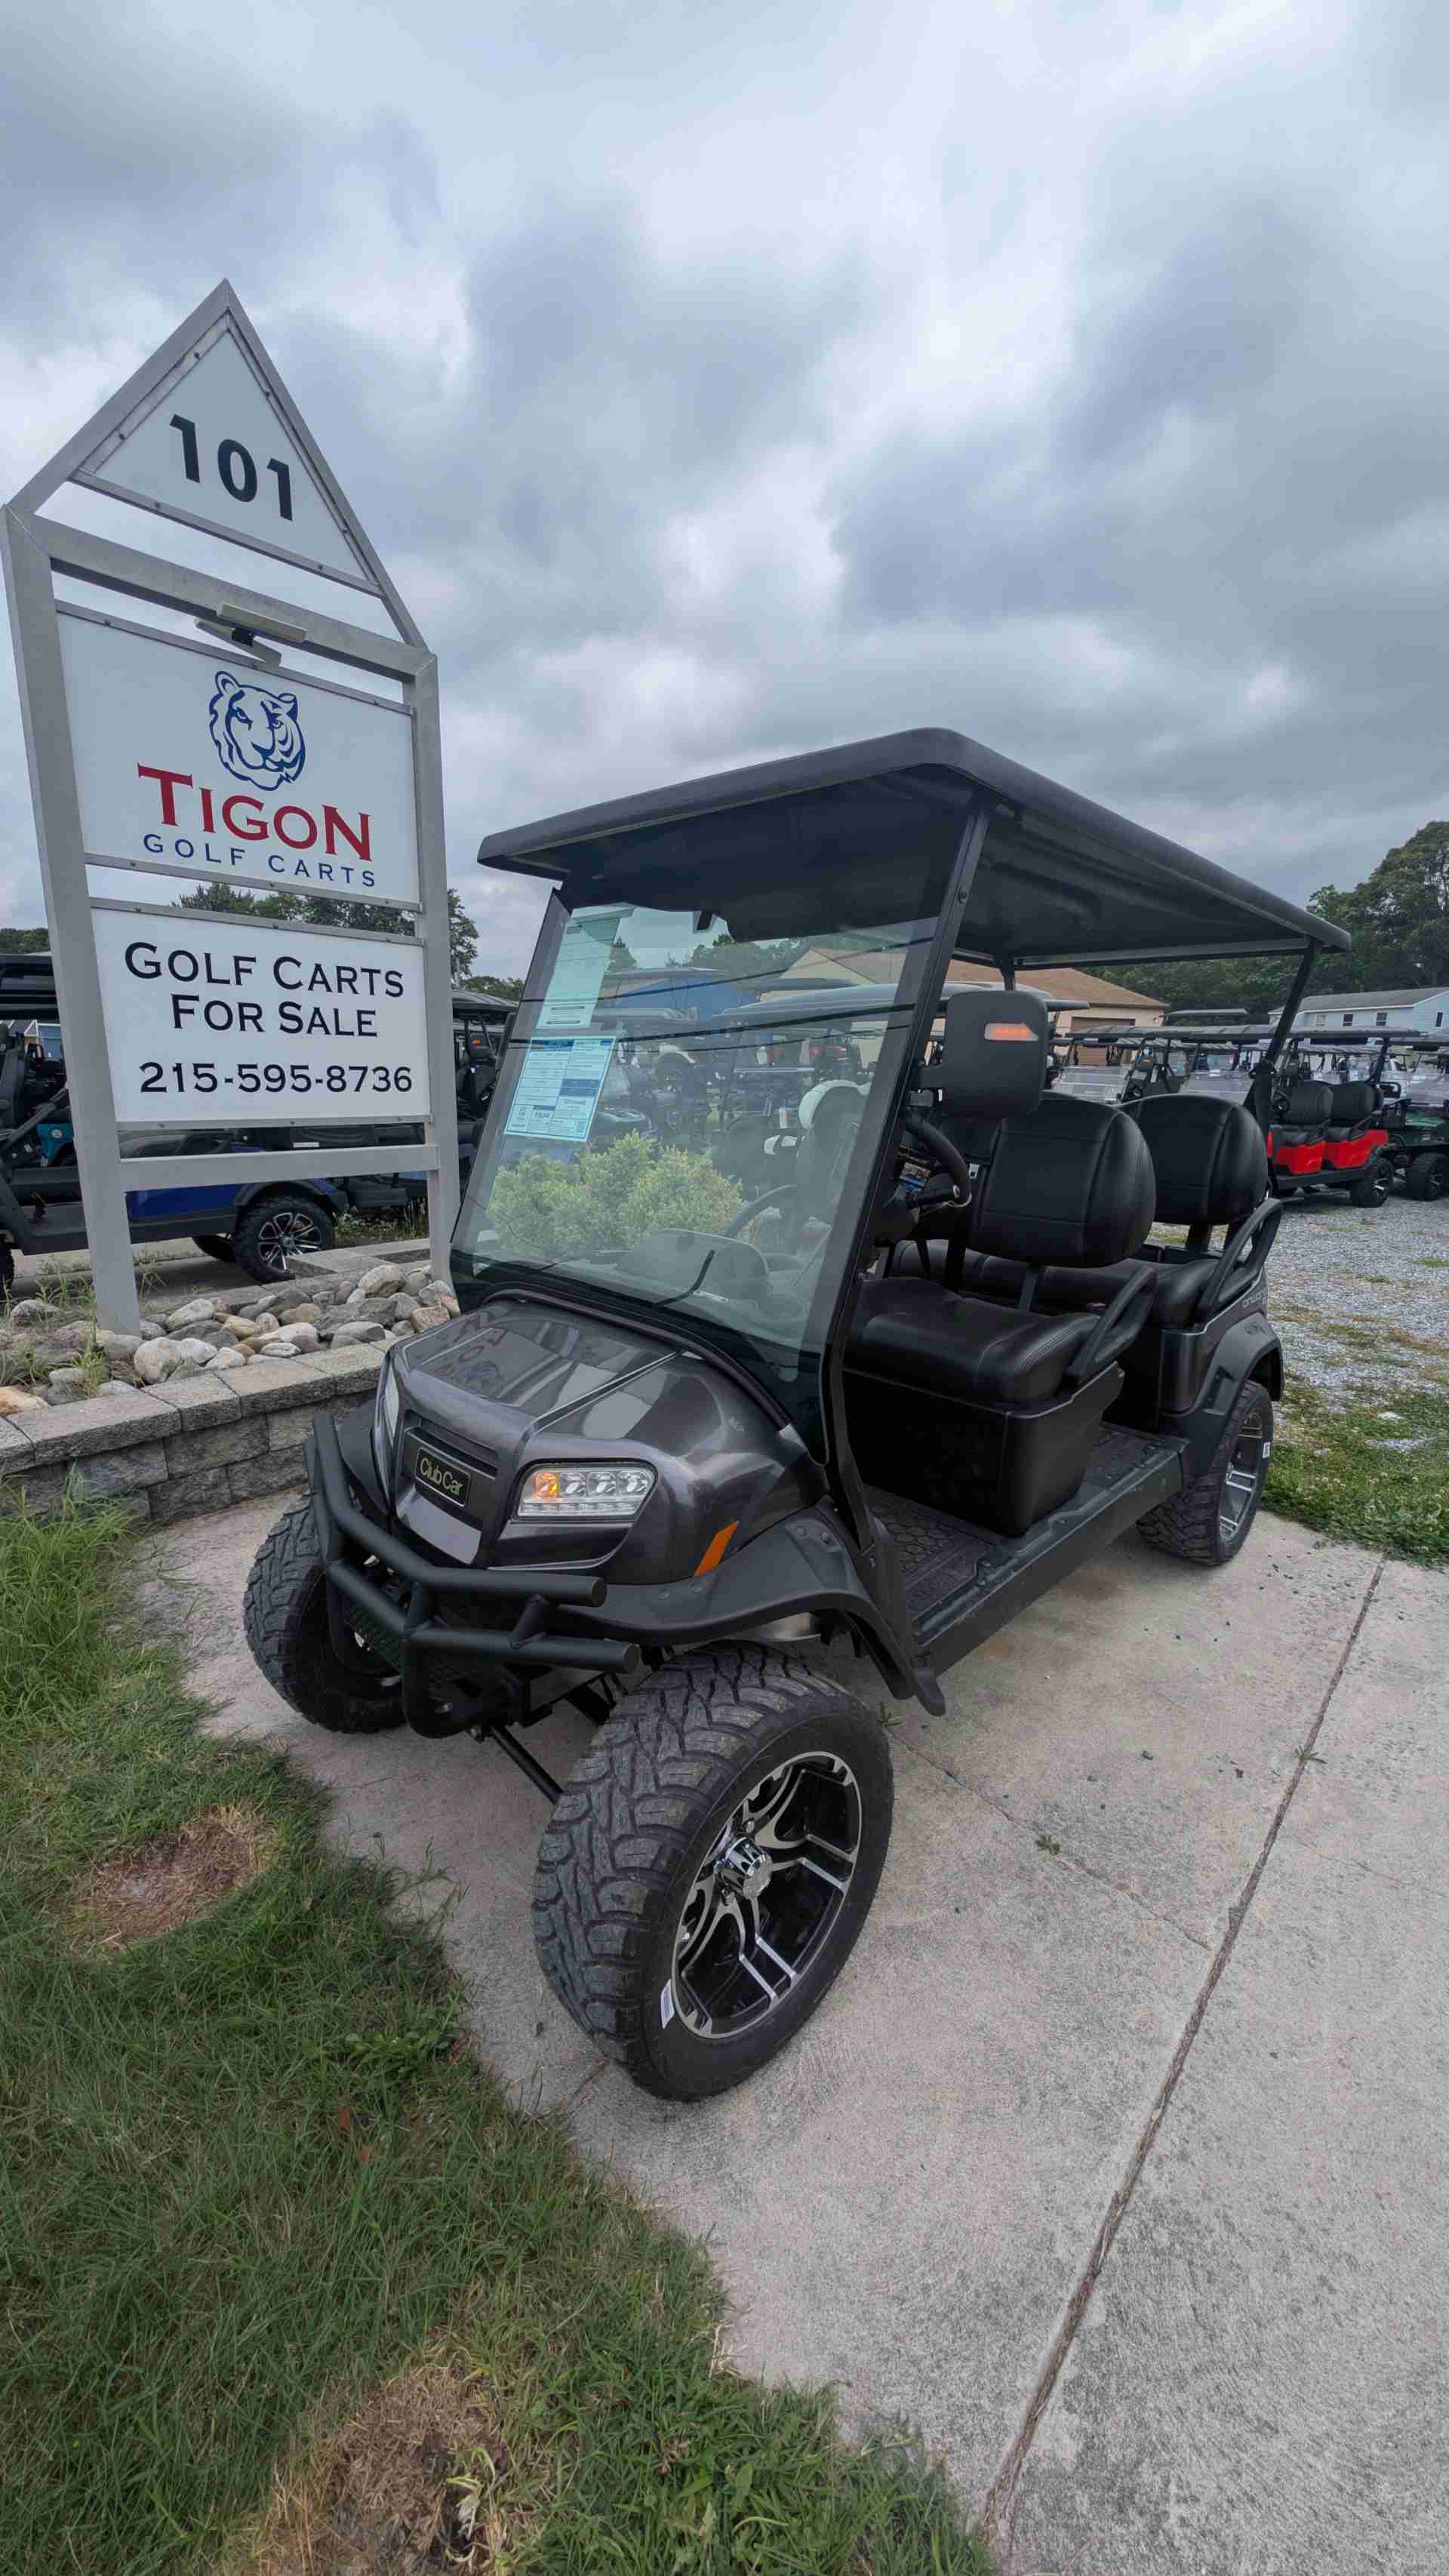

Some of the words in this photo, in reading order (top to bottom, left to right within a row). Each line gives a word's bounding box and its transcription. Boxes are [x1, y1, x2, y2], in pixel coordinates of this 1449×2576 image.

[170, 414, 293, 522] 101
[137, 762, 372, 862] TIGON
[143, 834, 245, 866] GOLF
[269, 854, 375, 888] CARTS
[125, 941, 257, 986] GOLF
[273, 956, 404, 998] CARTS
[171, 993, 265, 1033] FOR
[278, 1001, 377, 1037] SALE
[139, 1061, 412, 1093] 215-595-8736
